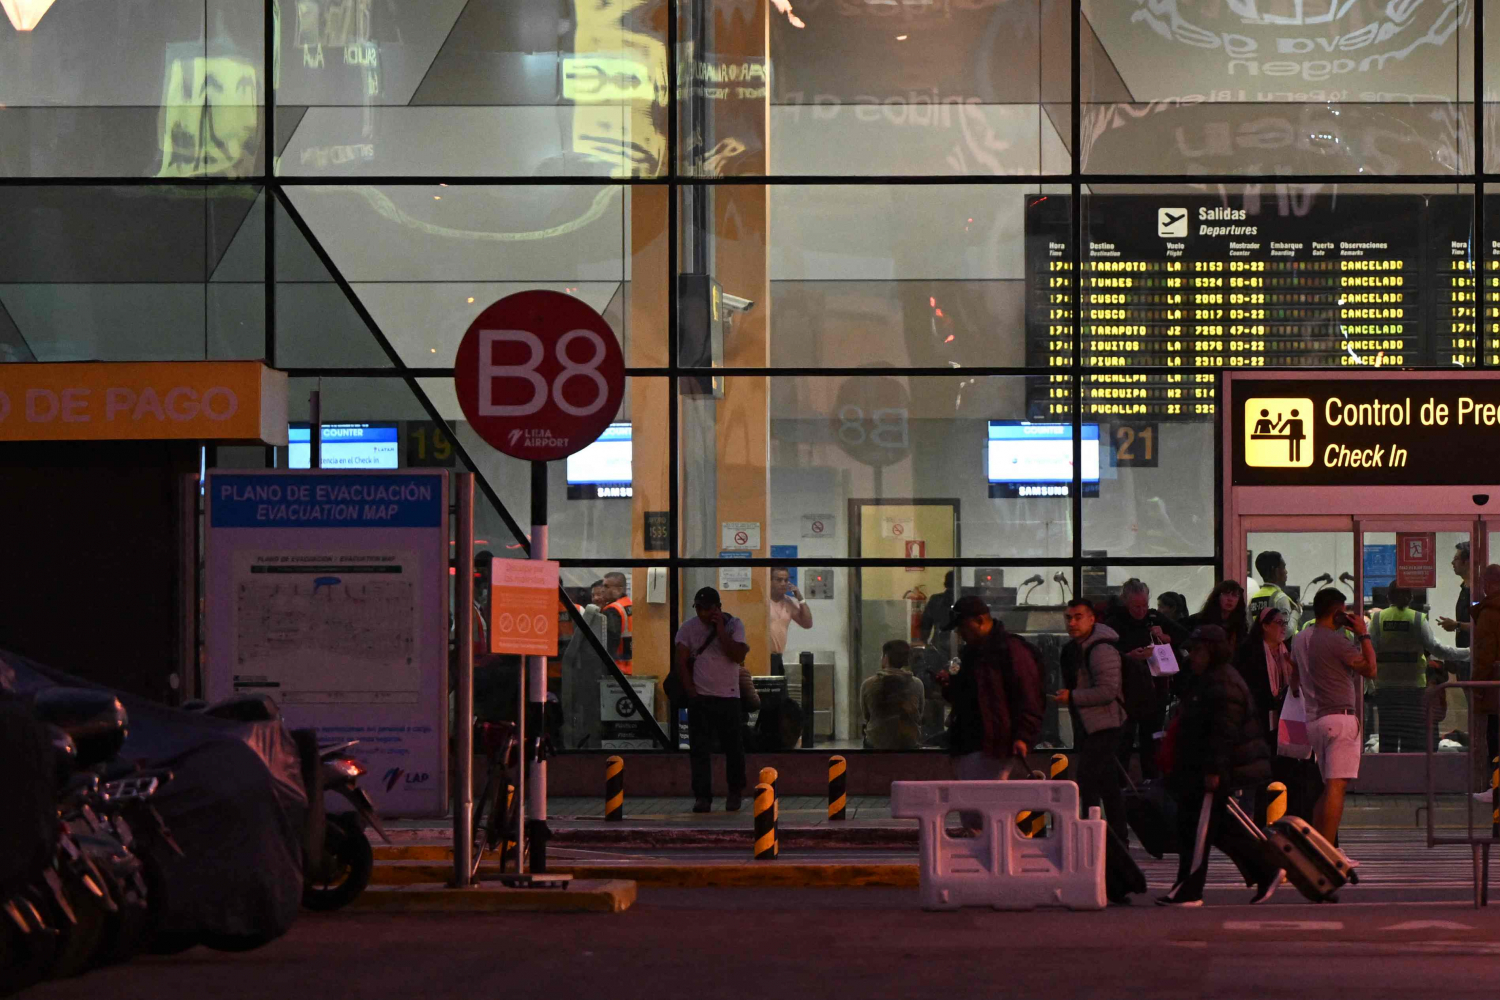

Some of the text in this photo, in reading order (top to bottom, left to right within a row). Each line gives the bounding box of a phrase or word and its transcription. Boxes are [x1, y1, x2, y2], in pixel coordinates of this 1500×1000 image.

[1198, 207, 1247, 221] Salidas
[1198, 224, 1258, 237] Departures
[1049, 242, 1388, 252] Hora Destino Vuelo Mostrador Embarque Puerta Observaciones
[1452, 240, 1468, 248] Hora
[1090, 262, 1146, 272] TARAPOTO
[1167, 262, 1182, 272] LA
[1195, 262, 1223, 272] 2153
[1340, 260, 1404, 270] CANCELADO
[1090, 278, 1132, 288] TUMBES
[1195, 278, 1223, 288] 5324
[1340, 276, 1404, 286] CANCELADO
[1090, 294, 1126, 304] CUSCO
[1167, 294, 1182, 304] LA
[1195, 294, 1223, 304] 2005
[1340, 294, 1404, 302] CANCELADO
[1090, 310, 1126, 319] CUSCO
[1167, 310, 1182, 319] LA
[1195, 310, 1223, 319] 2017
[1340, 308, 1404, 318] CANCELADO
[1090, 326, 1146, 336] TARAPOTO
[1167, 326, 1182, 336] JZ
[1340, 324, 1404, 334] CANCELADO
[1167, 341, 1182, 350] LA
[1340, 340, 1404, 350] CANCELADO
[1090, 356, 1126, 366] PIURA
[1167, 356, 1182, 366] LA
[1195, 356, 1223, 366] 2310
[478, 328, 609, 417] B8
[26, 388, 91, 422] DE
[106, 386, 238, 422] PAGO
[1090, 404, 1146, 414] PUCALLPA
[1324, 397, 1411, 427] Control
[1420, 398, 1450, 426] de
[323, 428, 364, 437] COUNTER
[411, 428, 452, 460] 19
[523, 438, 569, 448] AIRPORT
[1116, 426, 1152, 460] 21
[1324, 444, 1408, 468] Check In
[221, 482, 432, 501] PLANO DE EVACUACIÓN
[1018, 486, 1069, 496] SAMSUNG
[256, 504, 399, 520] EVACUATION MAP
[406, 773, 430, 784] LAP
